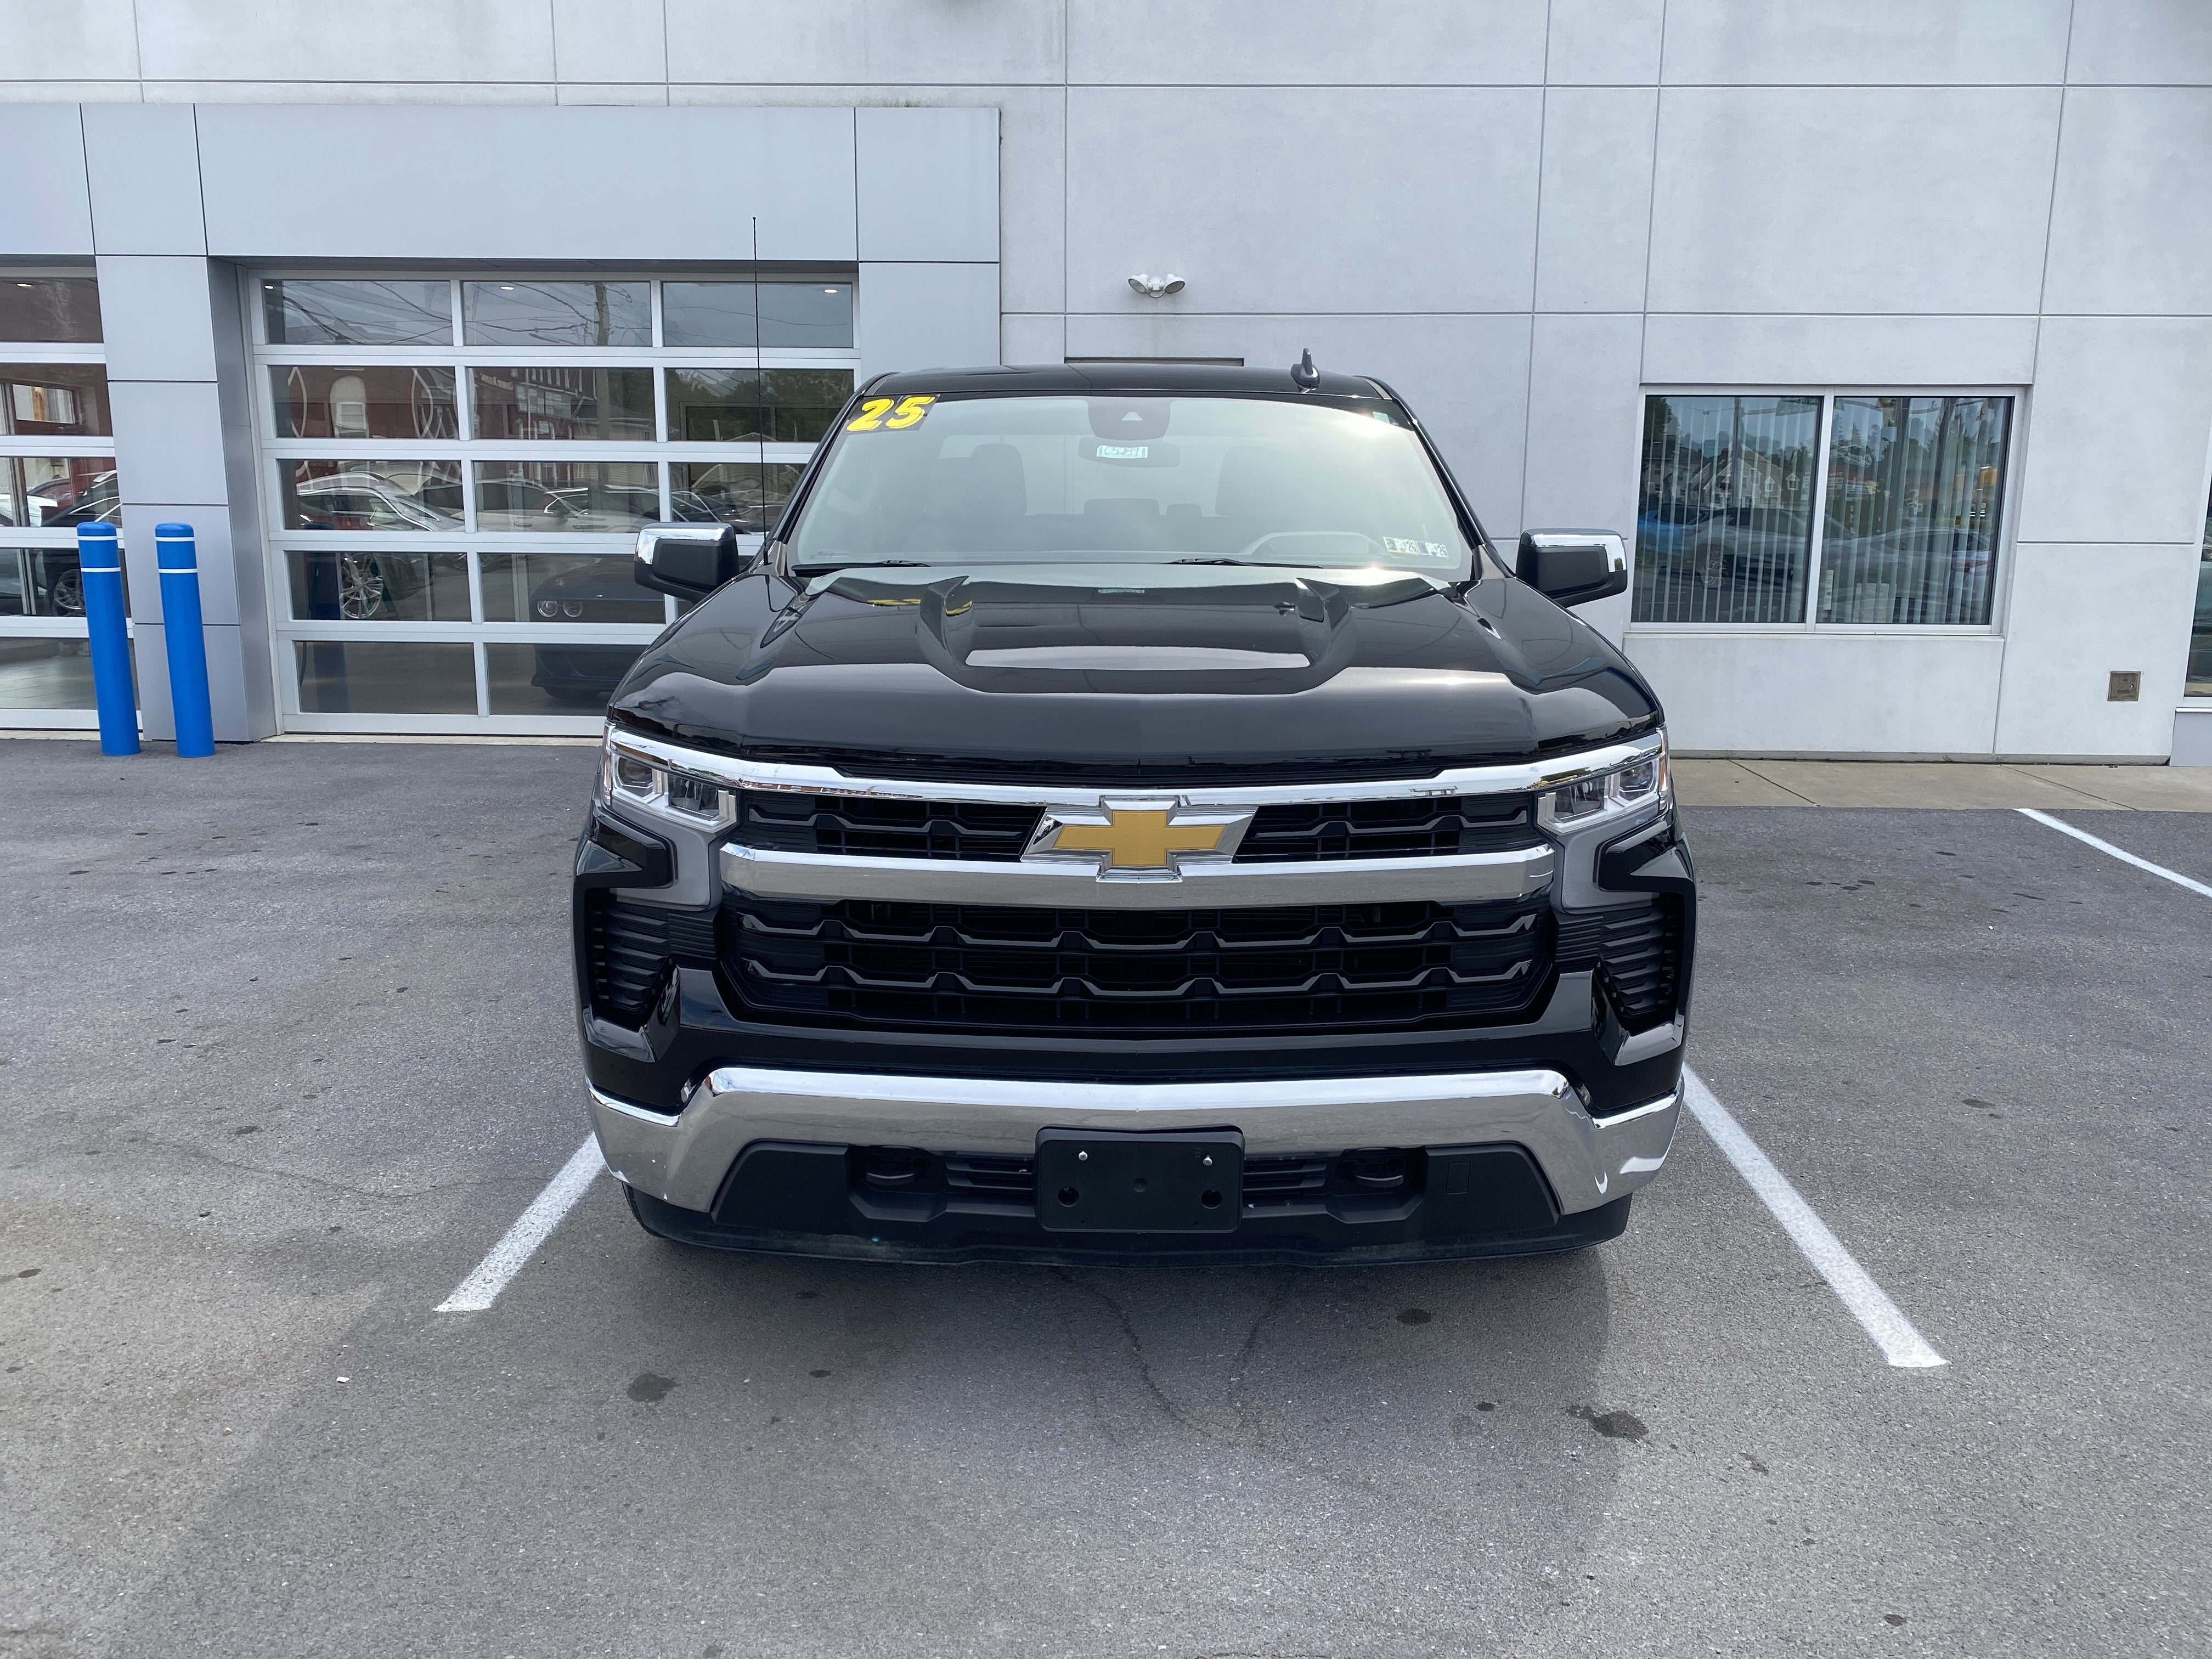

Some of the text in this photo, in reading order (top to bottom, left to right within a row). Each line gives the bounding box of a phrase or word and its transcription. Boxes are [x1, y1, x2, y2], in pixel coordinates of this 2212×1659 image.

[847, 396, 935, 432] 25
[1407, 541, 1417, 552] 26
[1437, 545, 1448, 556] 26
